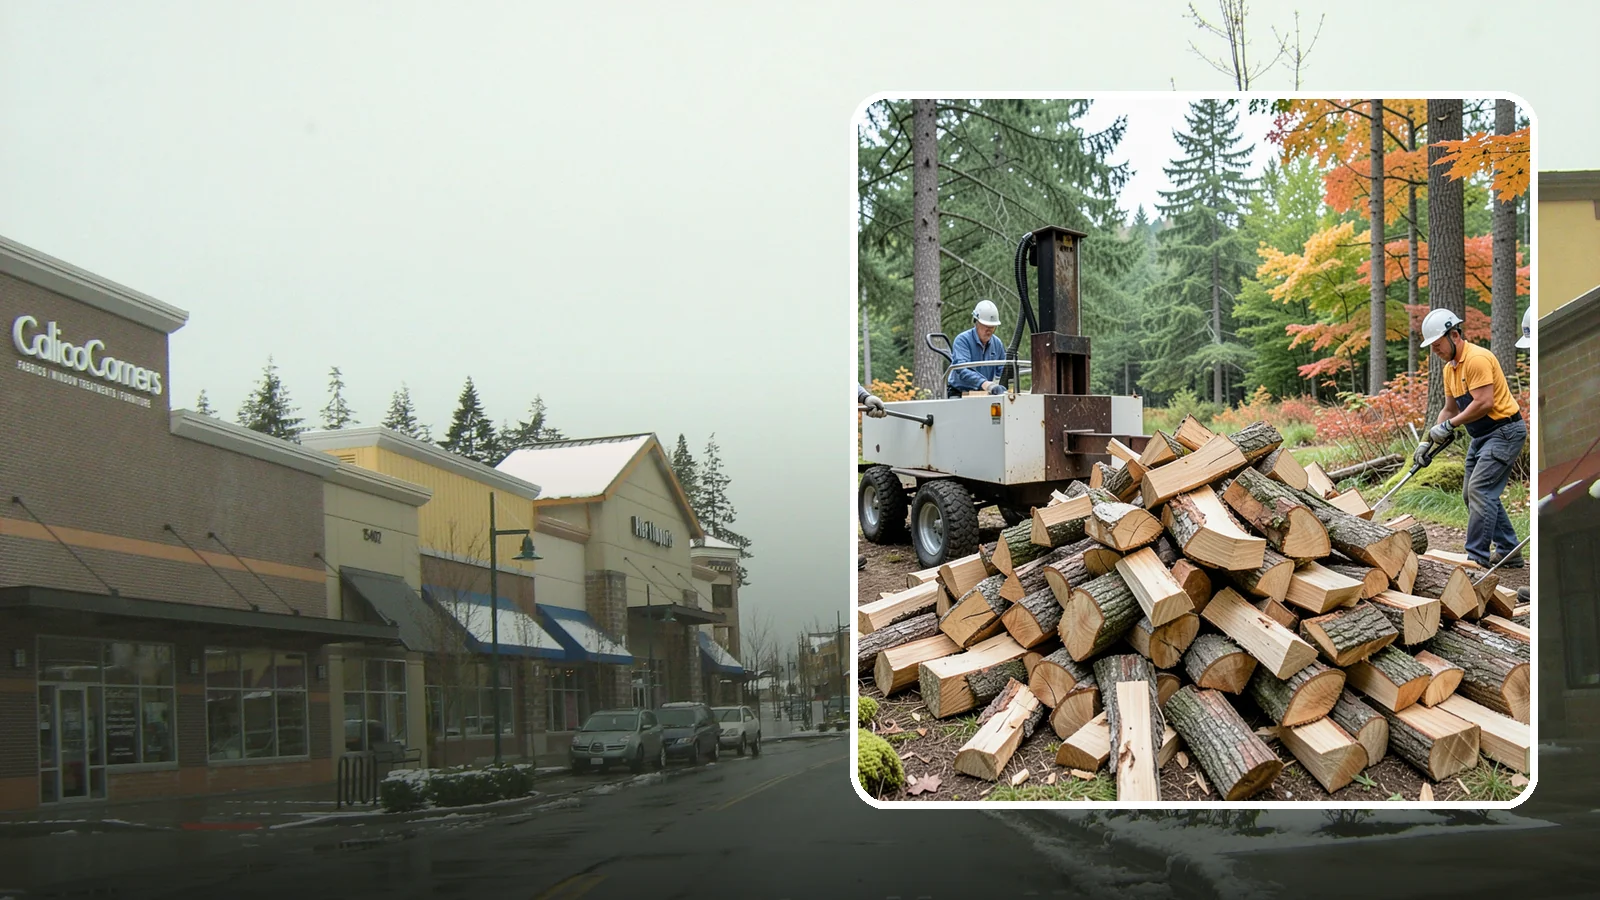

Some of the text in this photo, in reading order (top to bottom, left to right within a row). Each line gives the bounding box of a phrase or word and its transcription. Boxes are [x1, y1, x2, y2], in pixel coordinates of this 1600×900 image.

[16, 360, 151, 408] FABRICS WINDOW TREATMENTS FURNITURE
